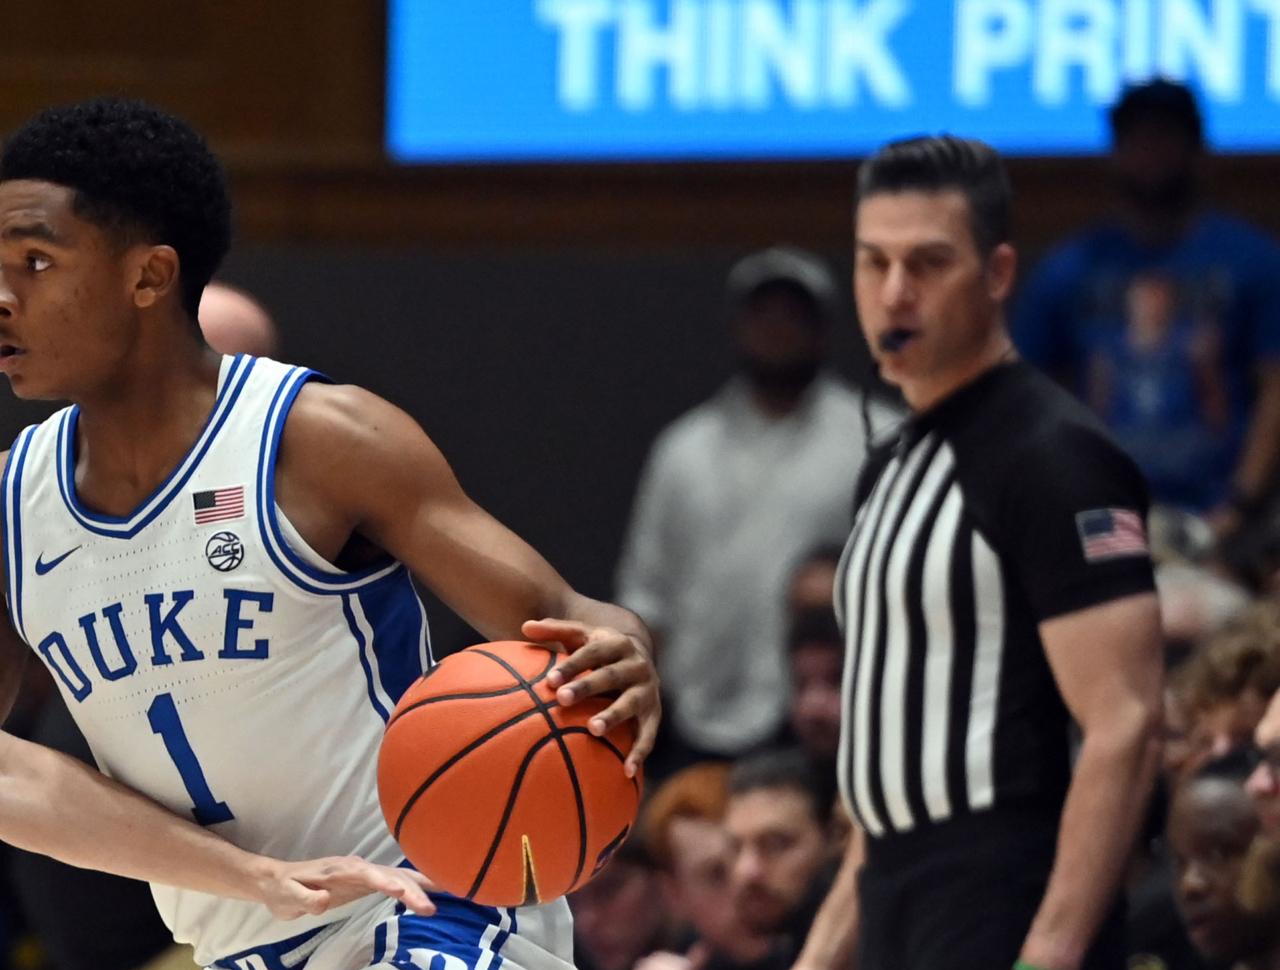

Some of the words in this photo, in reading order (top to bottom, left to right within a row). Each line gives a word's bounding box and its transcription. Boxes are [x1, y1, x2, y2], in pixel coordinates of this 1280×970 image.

[535, 0, 916, 110] THINK
[38, 588, 275, 703] DUKE
[147, 692, 235, 827] 1
